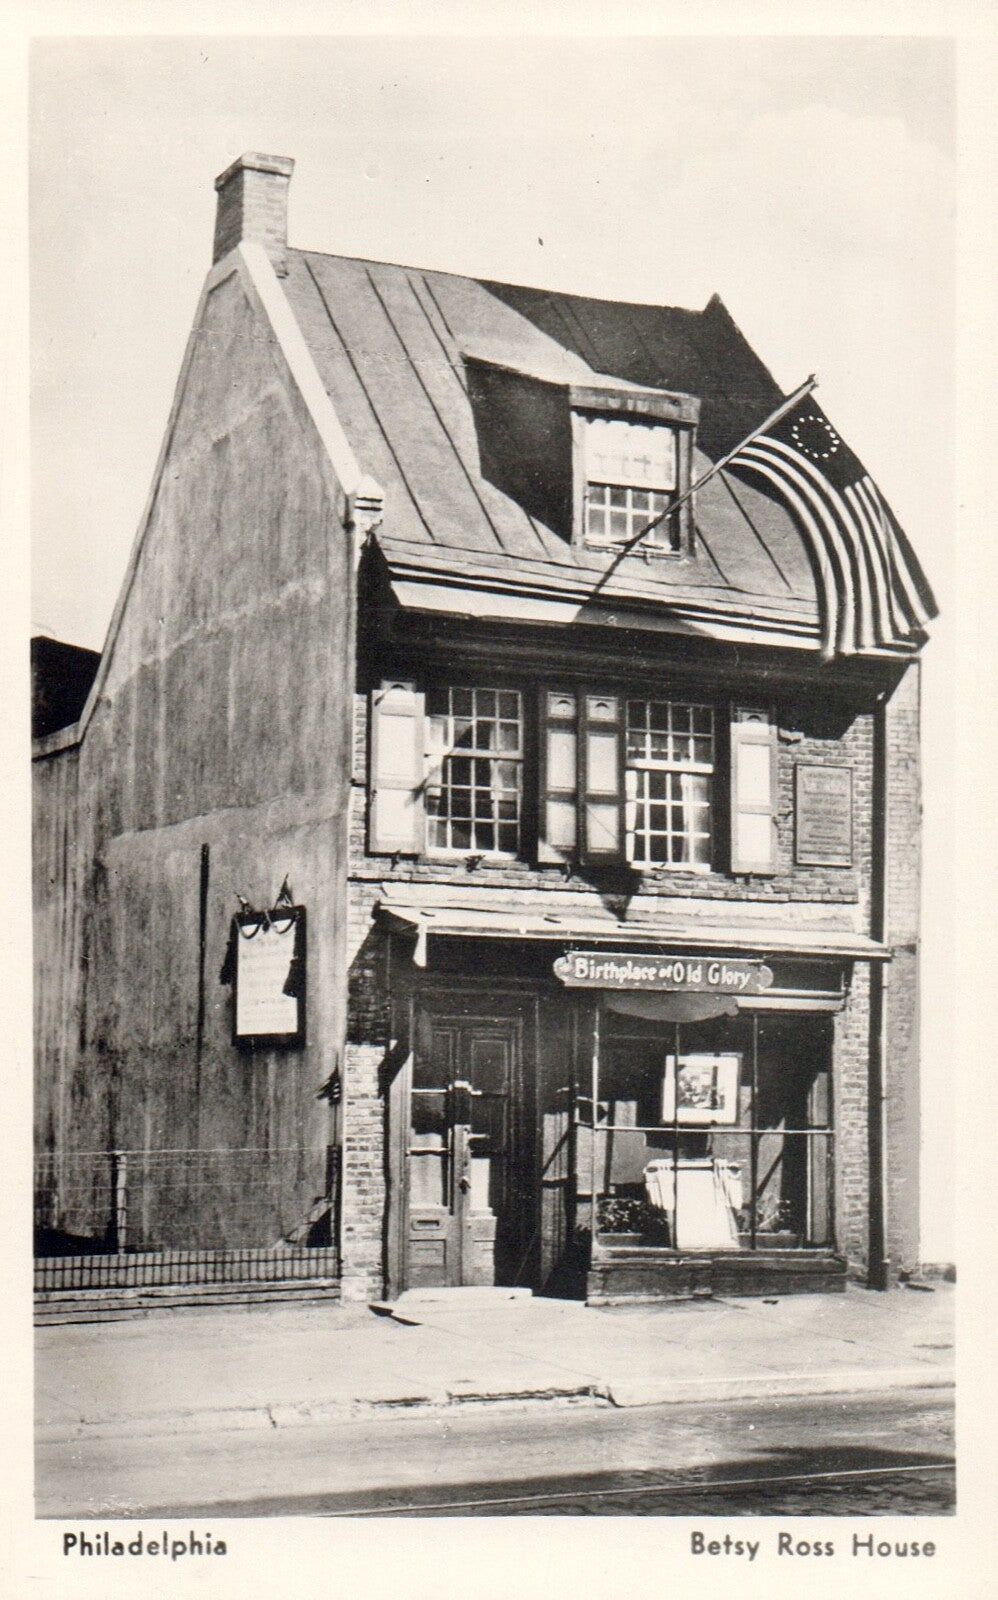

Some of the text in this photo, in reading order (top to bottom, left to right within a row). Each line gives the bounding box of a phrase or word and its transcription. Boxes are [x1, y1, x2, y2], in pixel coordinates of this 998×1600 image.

[574, 957, 752, 990] Birthplace of Old Glory
